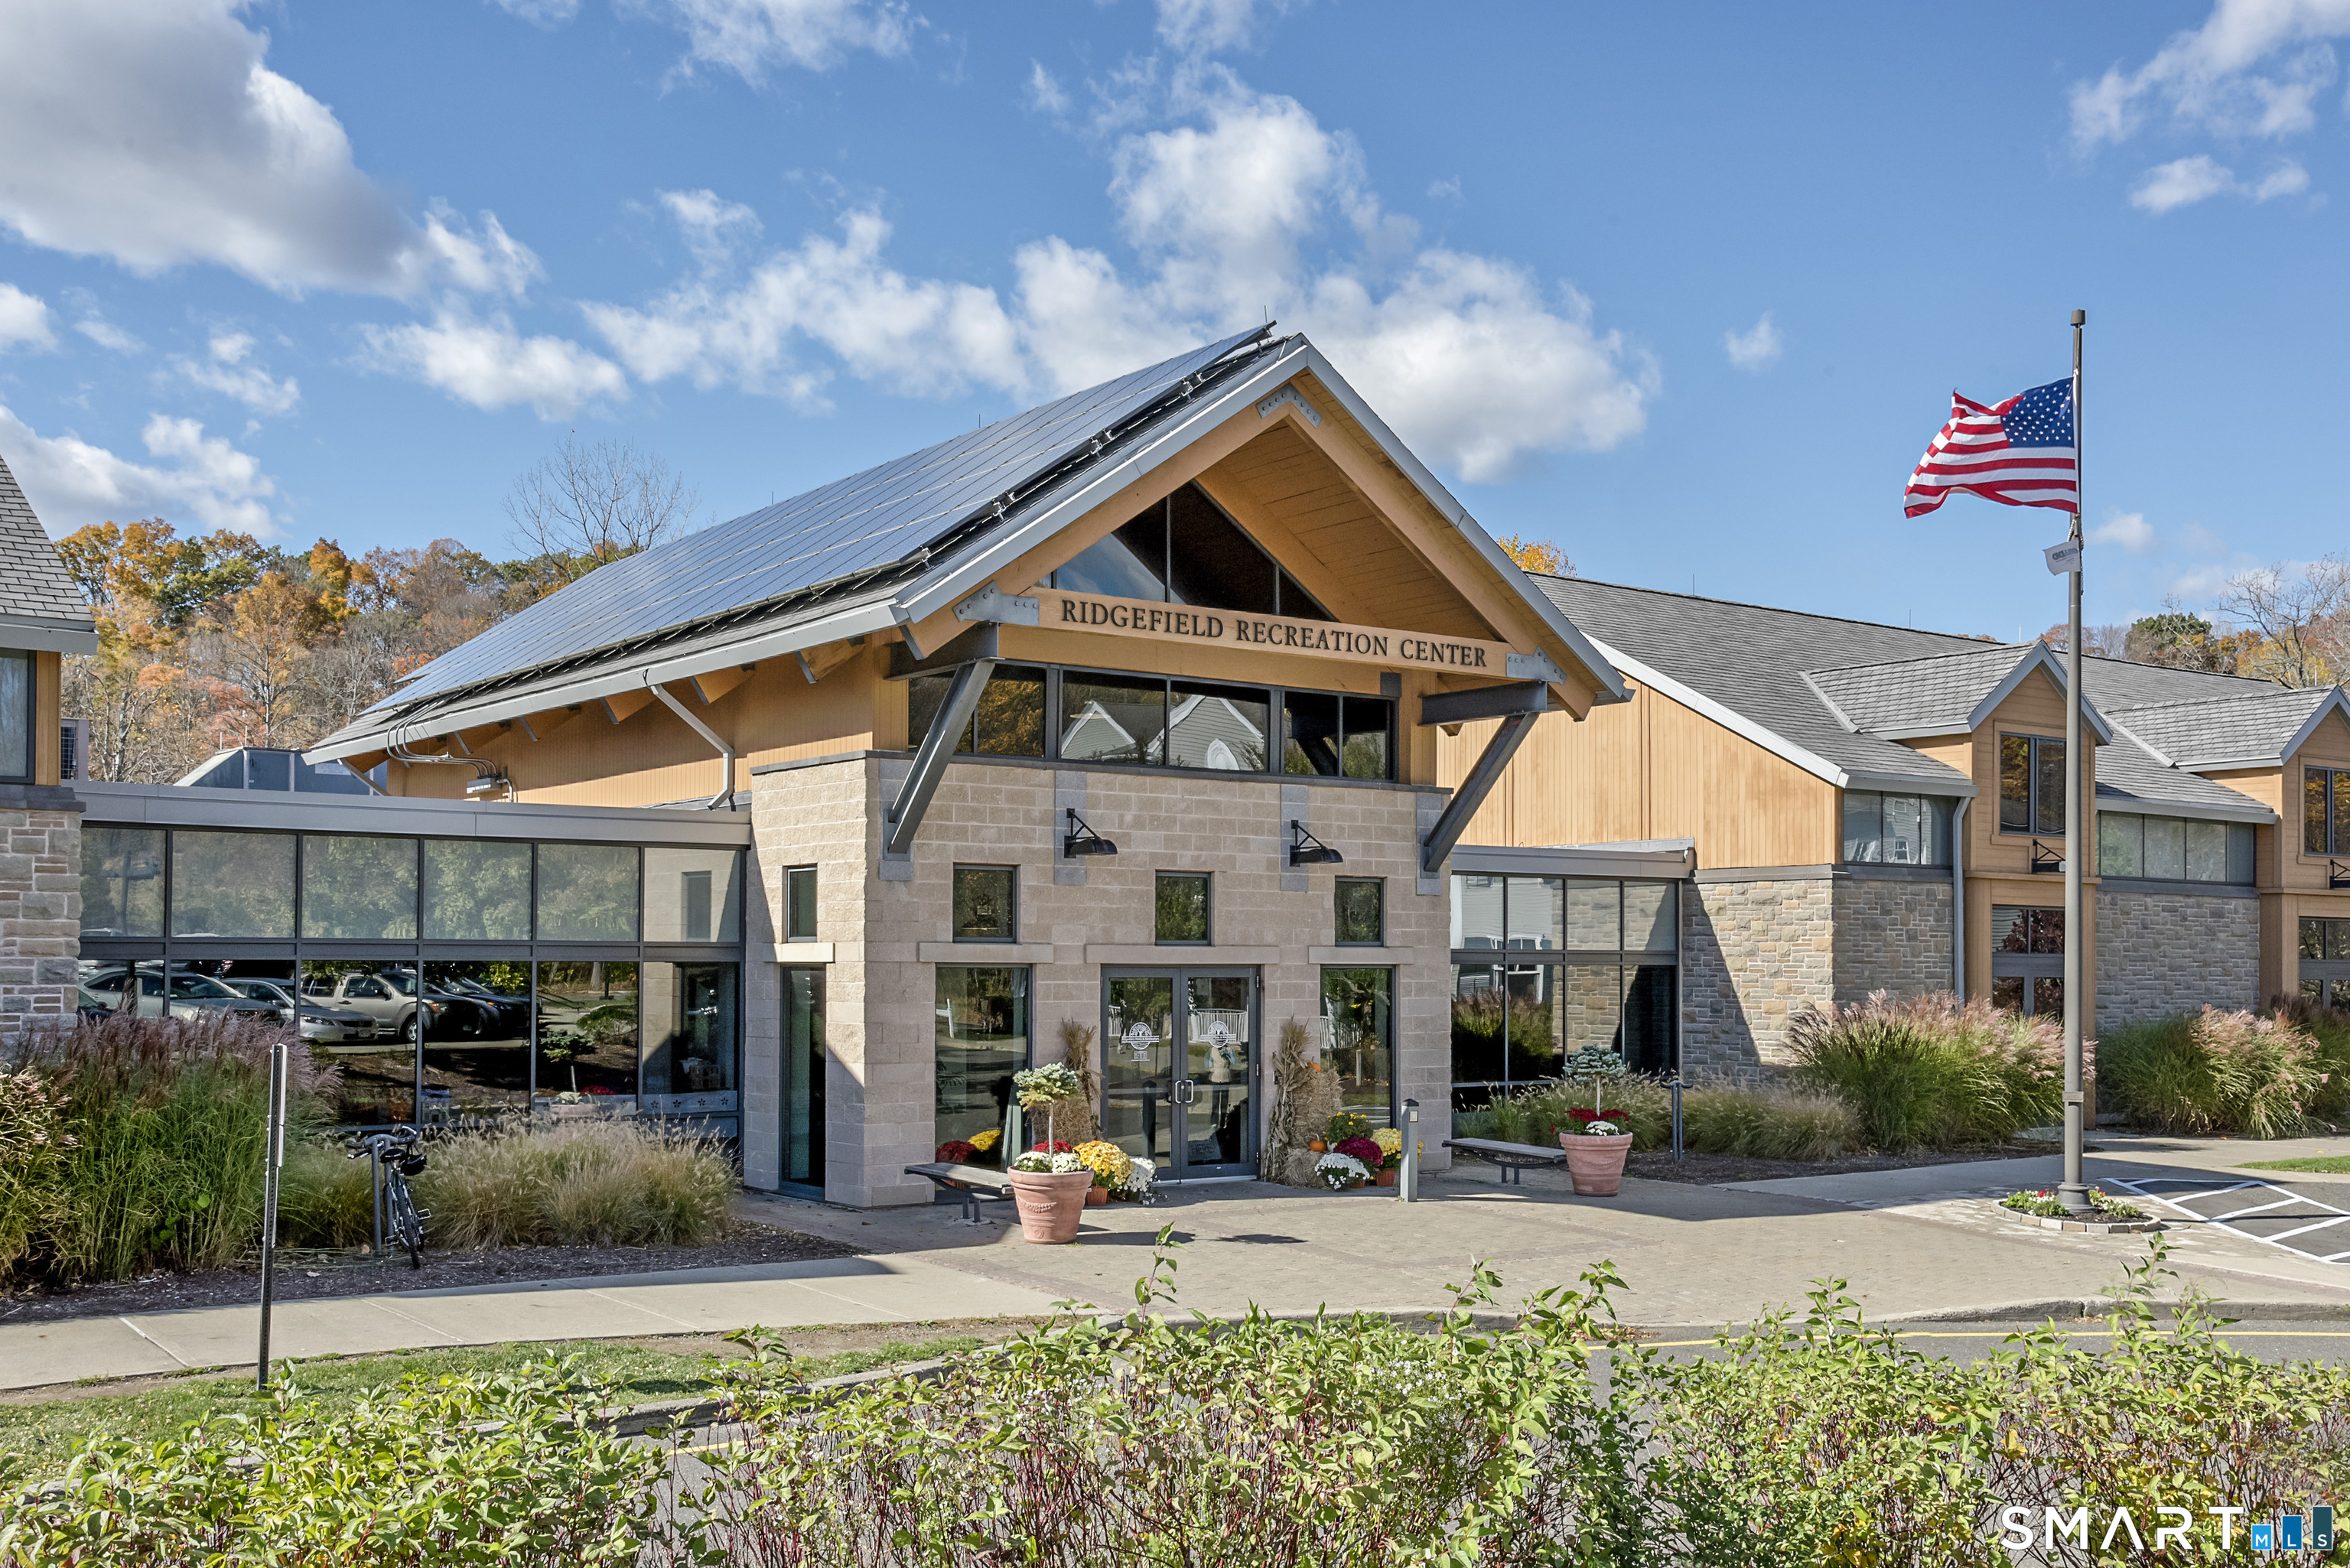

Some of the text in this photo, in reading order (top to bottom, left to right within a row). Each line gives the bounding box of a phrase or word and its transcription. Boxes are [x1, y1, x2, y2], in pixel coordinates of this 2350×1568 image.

[1062, 599, 1487, 668] RIDGEFIELD RECREATION CENTER
